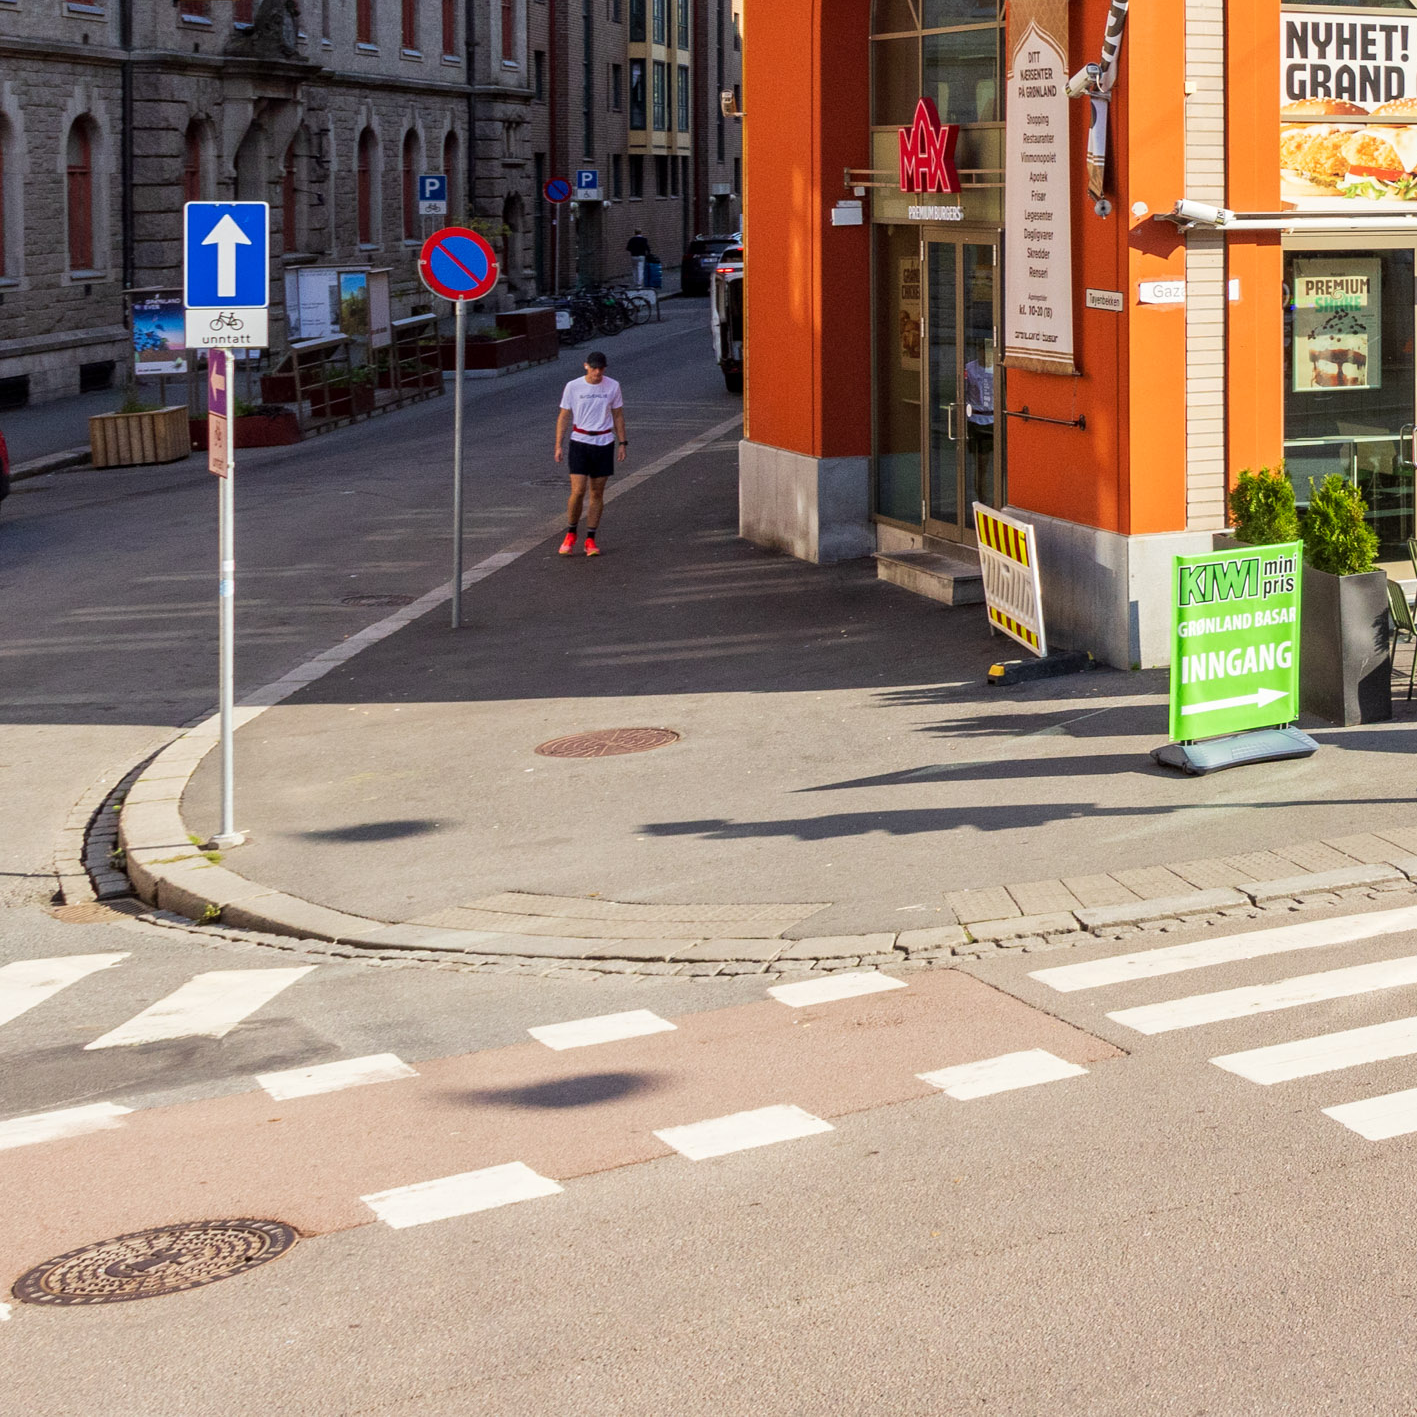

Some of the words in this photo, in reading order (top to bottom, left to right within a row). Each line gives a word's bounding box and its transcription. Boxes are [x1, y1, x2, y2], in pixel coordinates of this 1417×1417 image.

[1285, 20, 1410, 63] NYHET!
[1027, 51, 1041, 64] DITT
[1020, 67, 1054, 82] NÆRSENTER
[1285, 63, 1405, 102] GRAND
[1018, 86, 1026, 99] PÅ
[1026, 84, 1057, 99] GRØNLAND
[1026, 113, 1050, 126] Shopping
[898, 97, 959, 193] MAX
[1022, 133, 1055, 144] Restauranter
[1020, 151, 1057, 164] Vinmonopolet
[581, 172, 593, 187] P
[1029, 171, 1048, 184] Apotek
[425, 179, 440, 198] P
[1030, 190, 1047, 202] Frisør
[908, 206, 934, 220] PREMIUM
[933, 206, 961, 220] BURGERS
[1024, 209, 1053, 223] Legesenter
[1023, 228, 1054, 242] Dagligvarer
[1026, 247, 1050, 260] Skredder
[1028, 266, 1049, 279] Renseri
[1305, 277, 1371, 296] PREMIUM
[1089, 292, 1120, 308] Tøyenbekken
[202, 334, 251, 345] unntatt
[1178, 557, 1260, 607] KIWI
[1263, 552, 1297, 576] mini
[1263, 574, 1295, 600] pris
[1178, 613, 1251, 639] GRØNLAND
[1254, 606, 1297, 628] BASAR
[1181, 640, 1292, 684] INNGANG
